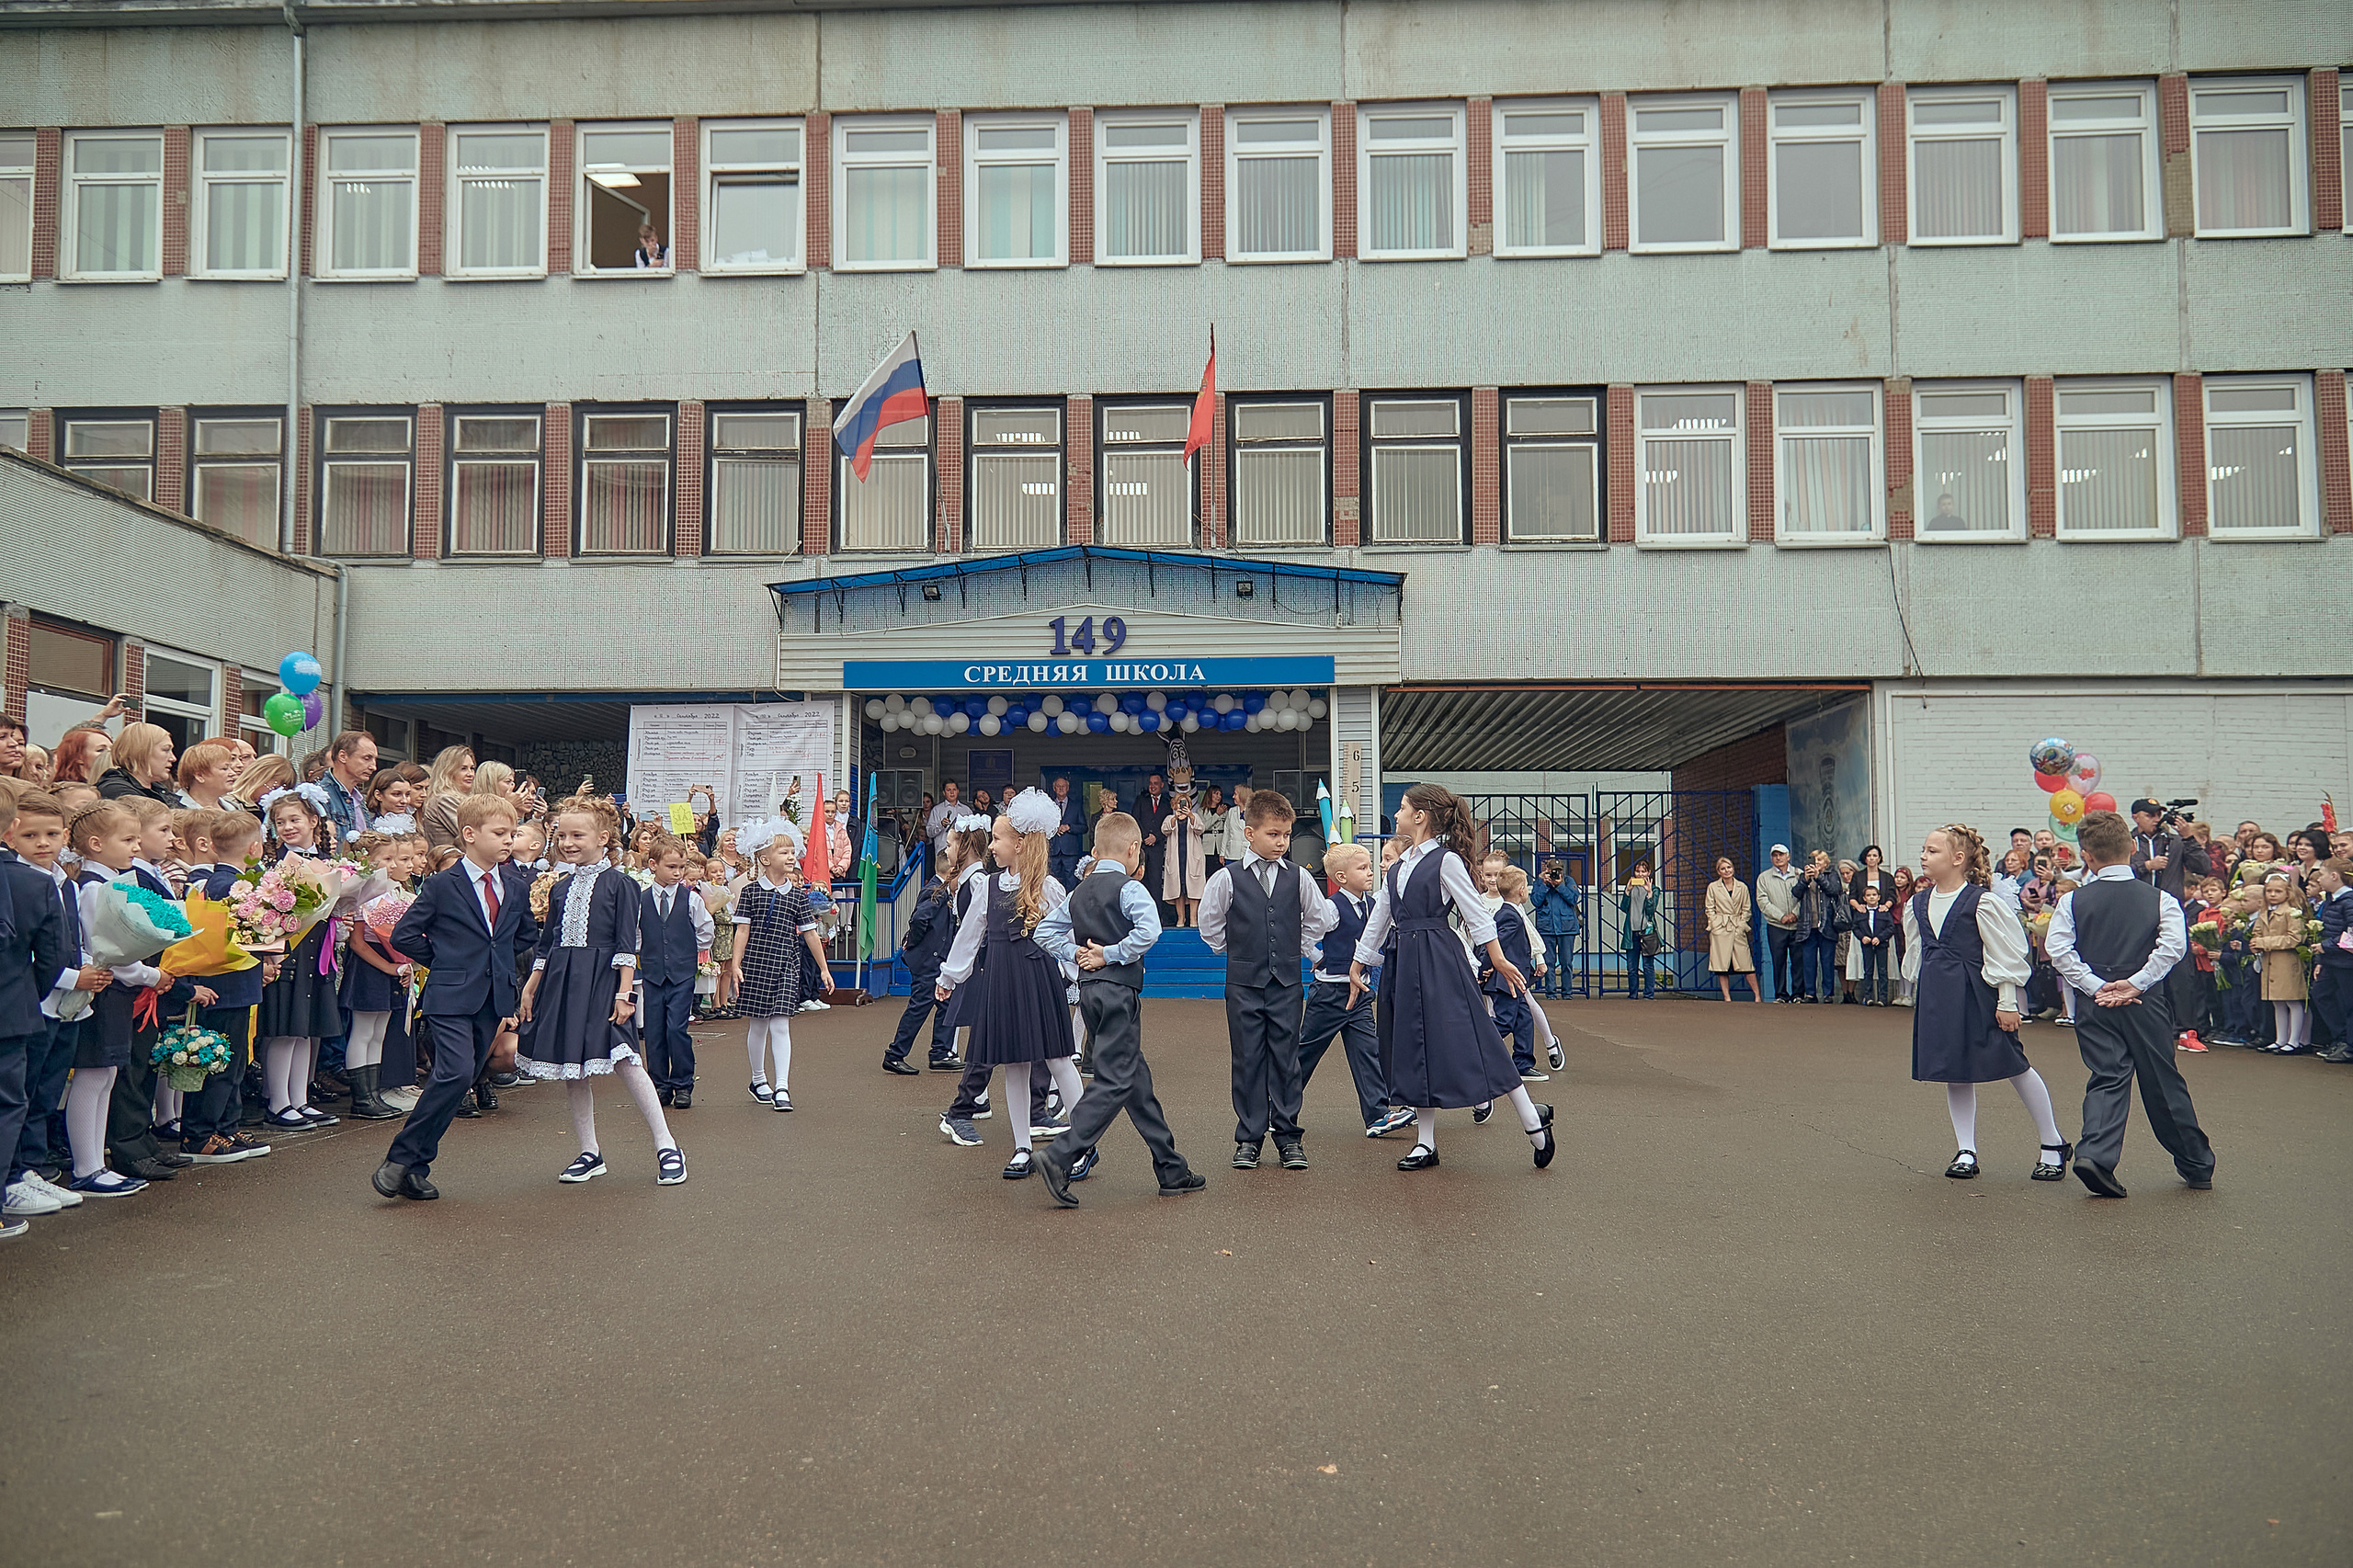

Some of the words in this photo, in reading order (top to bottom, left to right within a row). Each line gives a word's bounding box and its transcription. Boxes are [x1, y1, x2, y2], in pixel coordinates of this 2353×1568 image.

[1049, 616, 1127, 654] 149
[964, 665, 1088, 686] СРЕДНЯЯ
[1105, 664, 1206, 681] ШКОЛА
[1353, 750, 1360, 761] 6
[1351, 781, 1359, 792] 5
